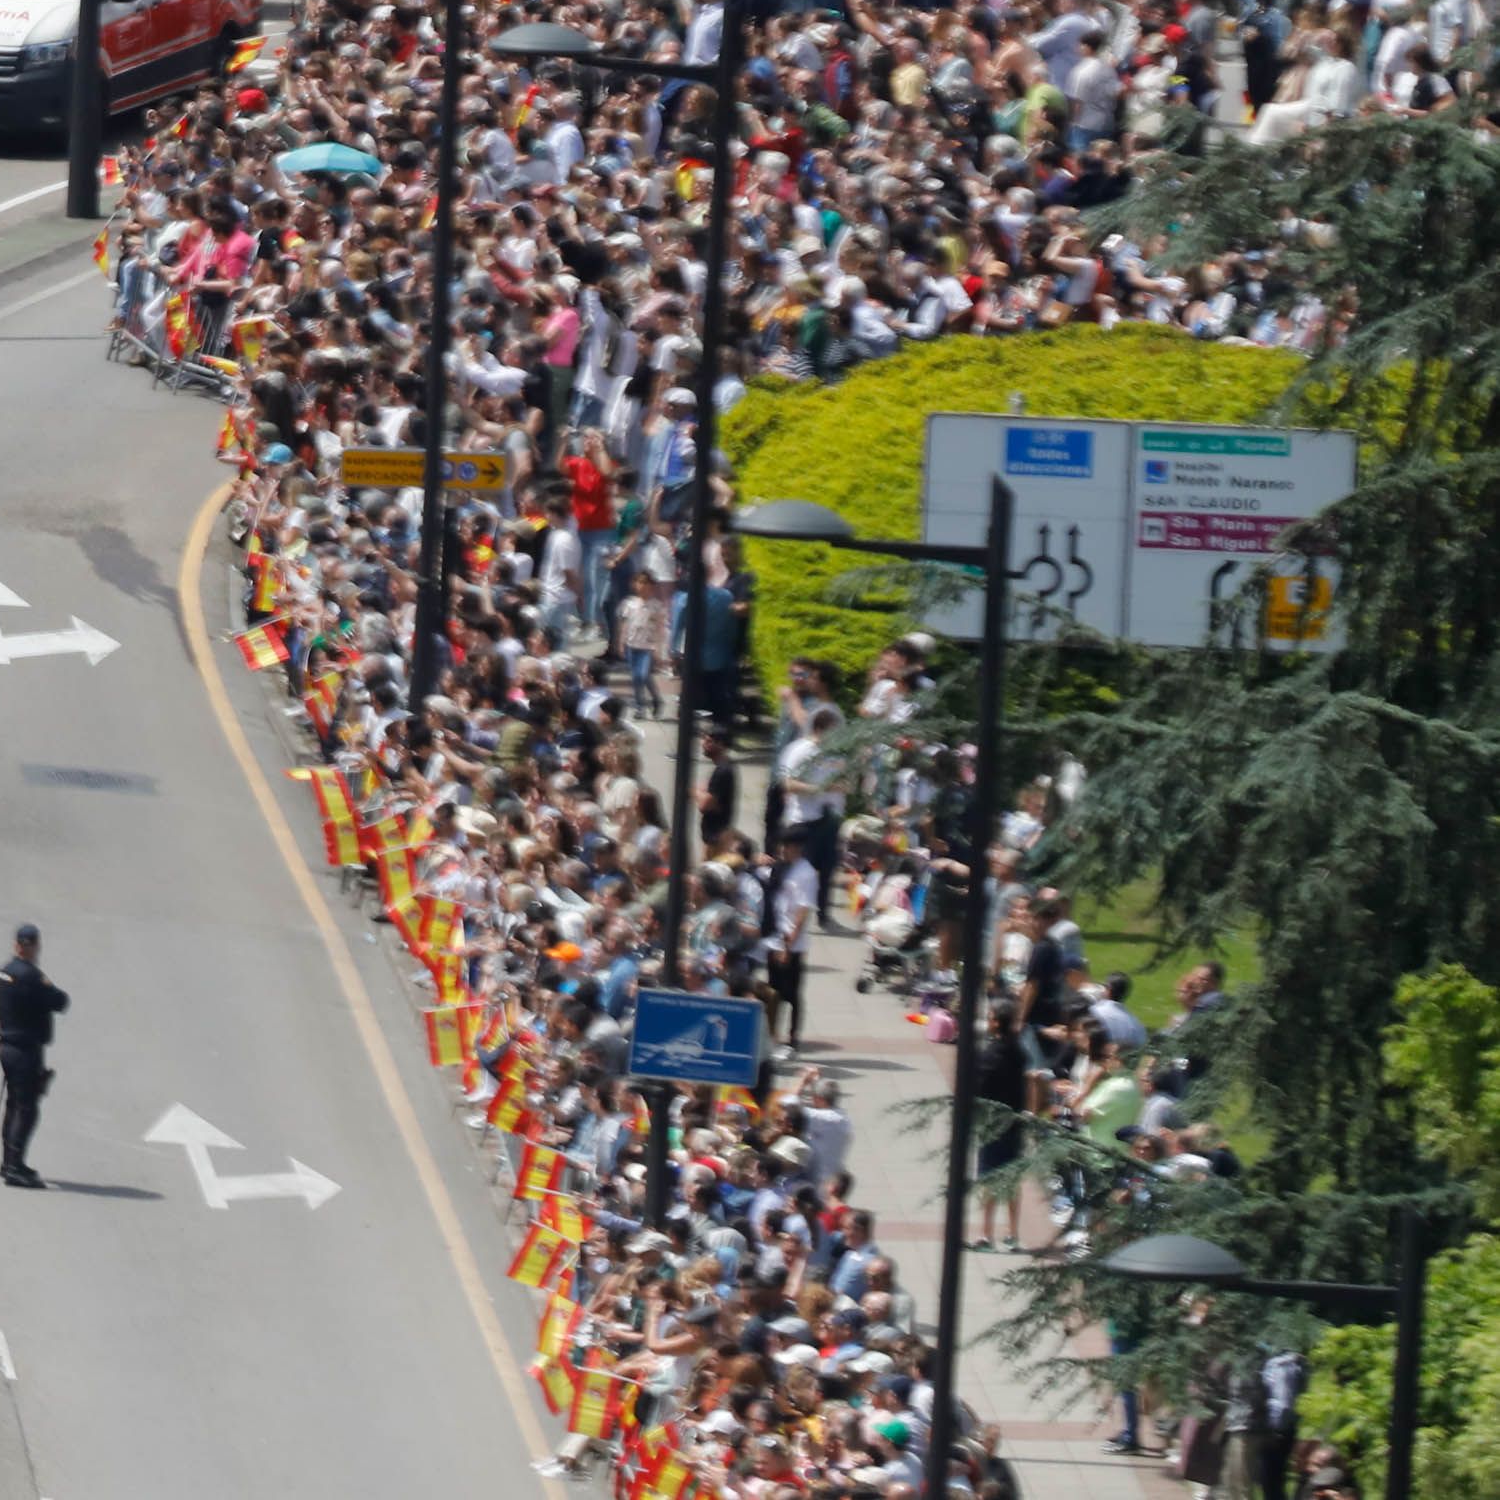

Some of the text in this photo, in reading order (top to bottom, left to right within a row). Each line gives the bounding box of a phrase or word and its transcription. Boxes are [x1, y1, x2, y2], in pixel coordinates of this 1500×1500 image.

[1144, 495, 1262, 511] SAN CLAUDIO
[1170, 533, 1201, 547] San
